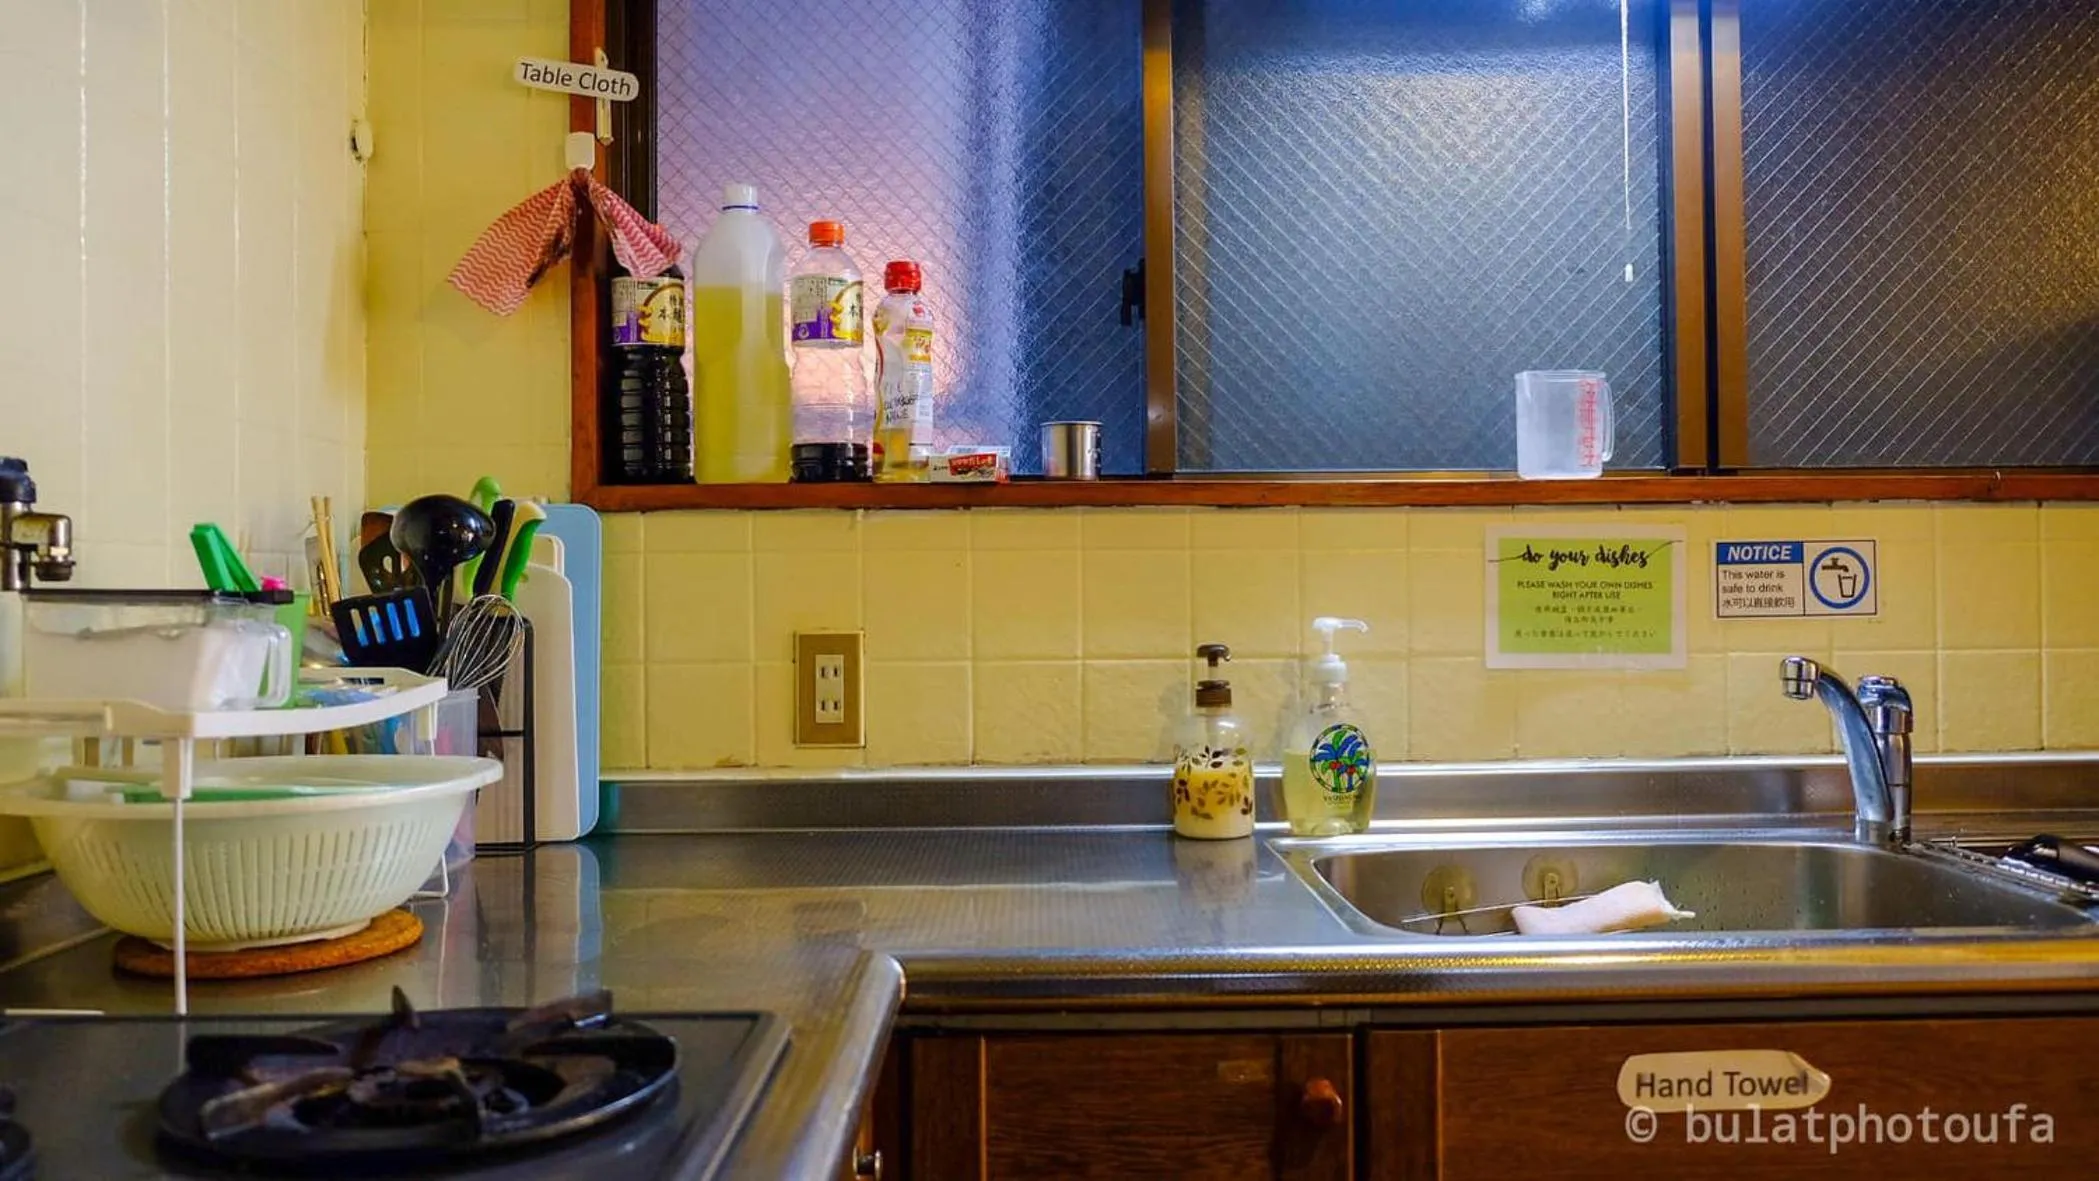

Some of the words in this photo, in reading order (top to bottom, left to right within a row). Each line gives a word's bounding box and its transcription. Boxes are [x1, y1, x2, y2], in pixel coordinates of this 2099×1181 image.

[520, 62, 573, 87] Table
[579, 71, 632, 96] Cloth
[1521, 544, 1544, 563] do
[1548, 549, 1589, 571] your
[1595, 544, 1649, 568] dishes
[1727, 544, 1792, 561] NOTICE
[1722, 570, 1744, 580] This
[1745, 570, 1774, 580] water
[1776, 569, 1786, 579] is
[1517, 580, 1545, 589] PLEASE
[1547, 580, 1573, 589] WASH
[1575, 580, 1598, 589] YOUR
[1600, 580, 1622, 589] OWN
[1624, 580, 1653, 589] DISHES
[1721, 583, 1743, 593] safe
[1745, 583, 1756, 593] to
[1758, 582, 1783, 593] drink
[1552, 591, 1577, 600] RIGHT
[1579, 591, 1602, 600] AFTER
[1604, 591, 1621, 600] USE
[1635, 1071, 1713, 1098] Hand
[1722, 1070, 1809, 1097] Towel
